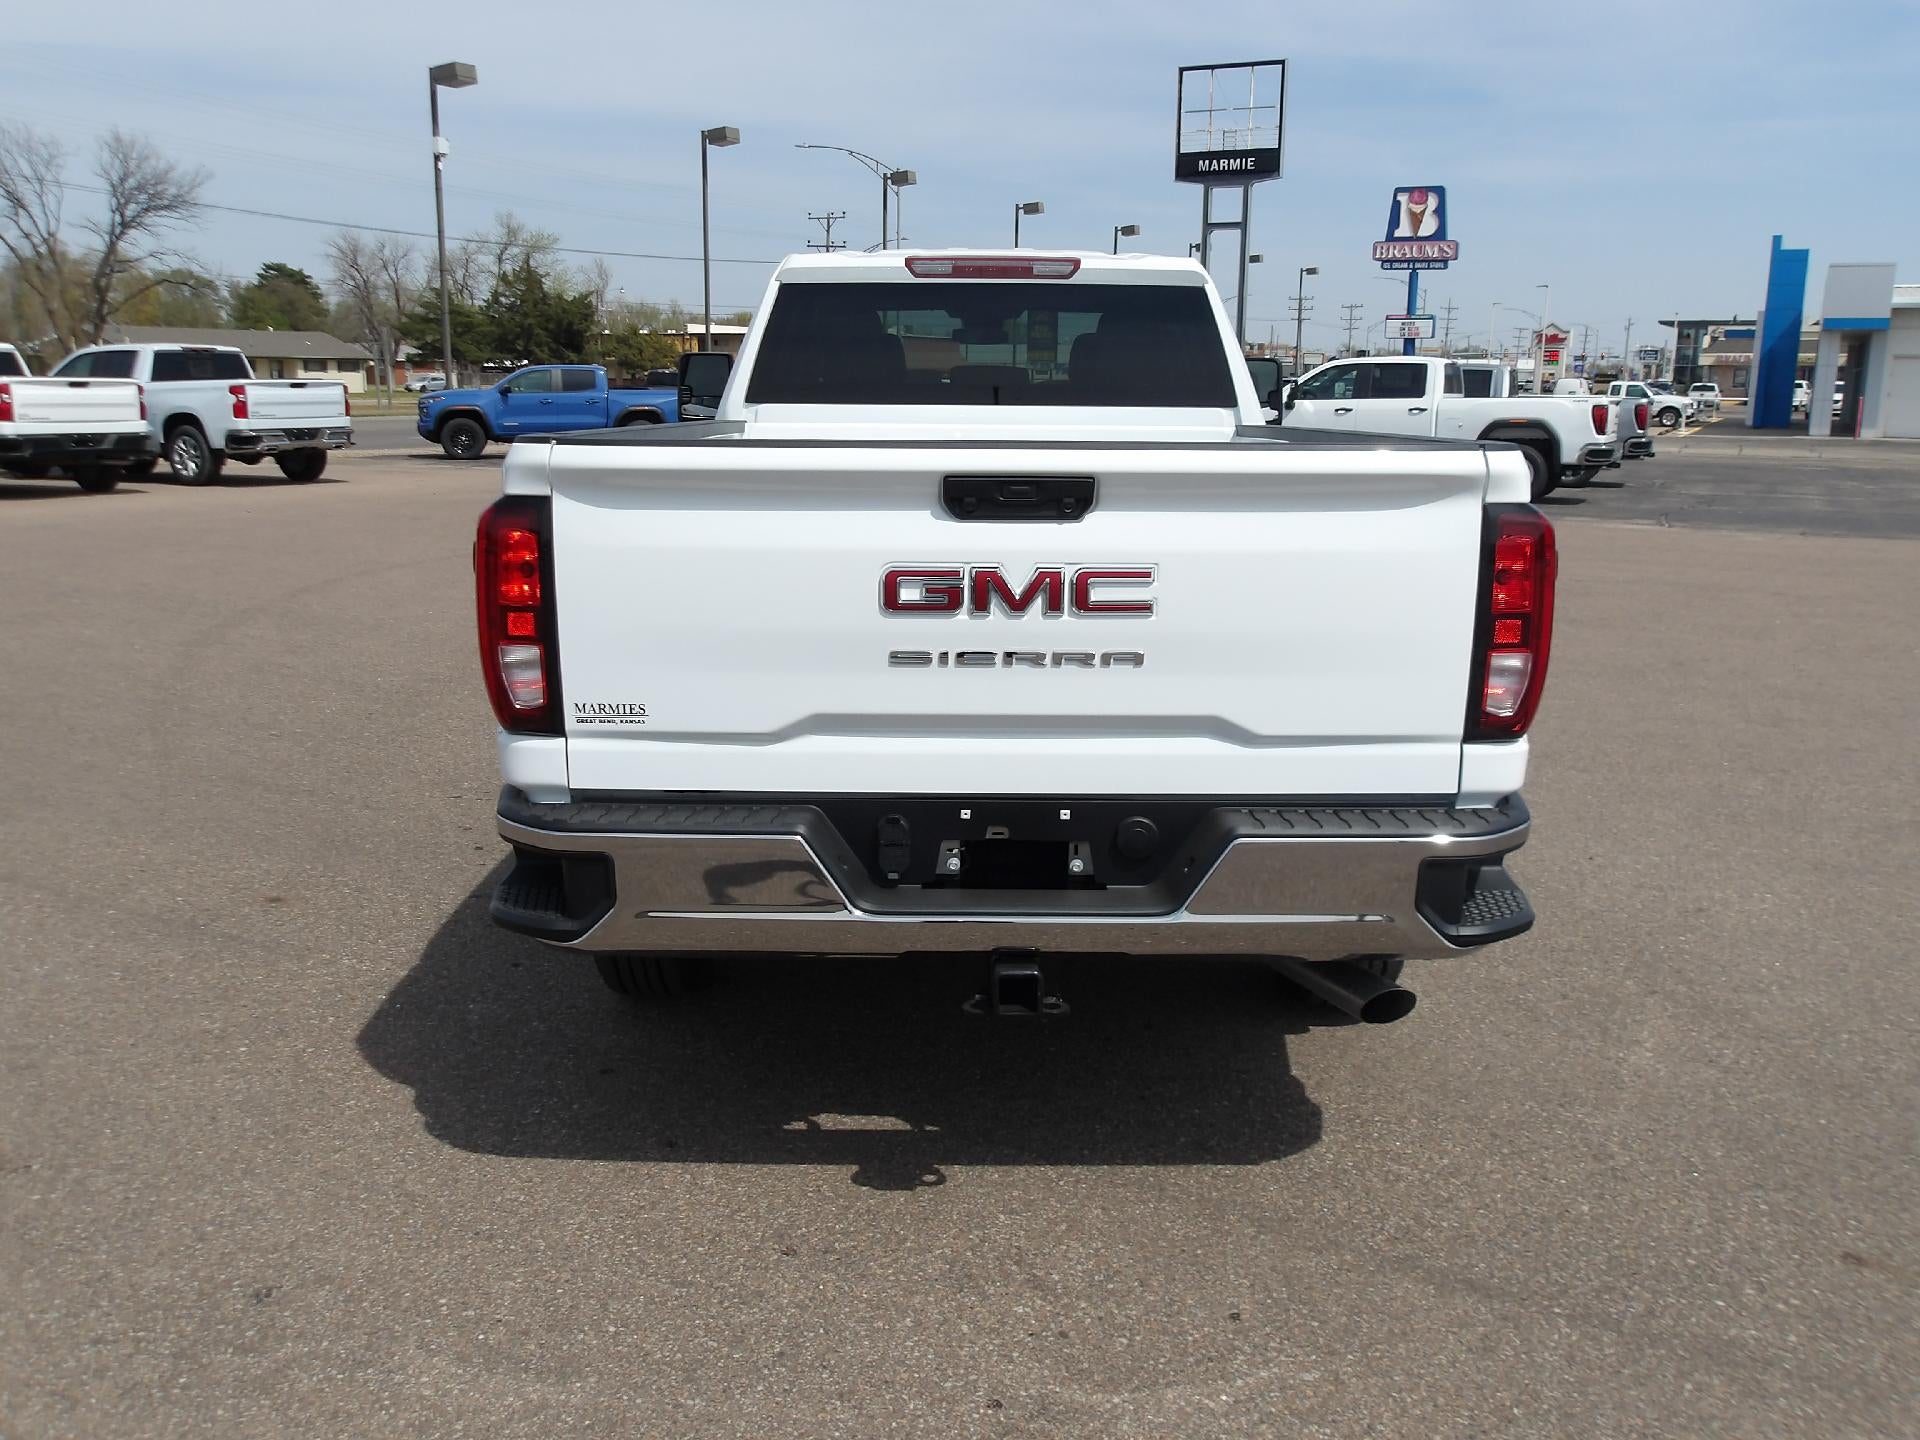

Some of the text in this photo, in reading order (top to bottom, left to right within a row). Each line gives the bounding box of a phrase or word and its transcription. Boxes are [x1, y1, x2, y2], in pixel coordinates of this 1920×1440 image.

[1198, 157, 1256, 172] MARMIE
[1375, 243, 1454, 259] BRAUM'S
[879, 563, 1157, 618] GMC
[888, 650, 1145, 668] SIERRA
[574, 702, 647, 715] MARMIES
